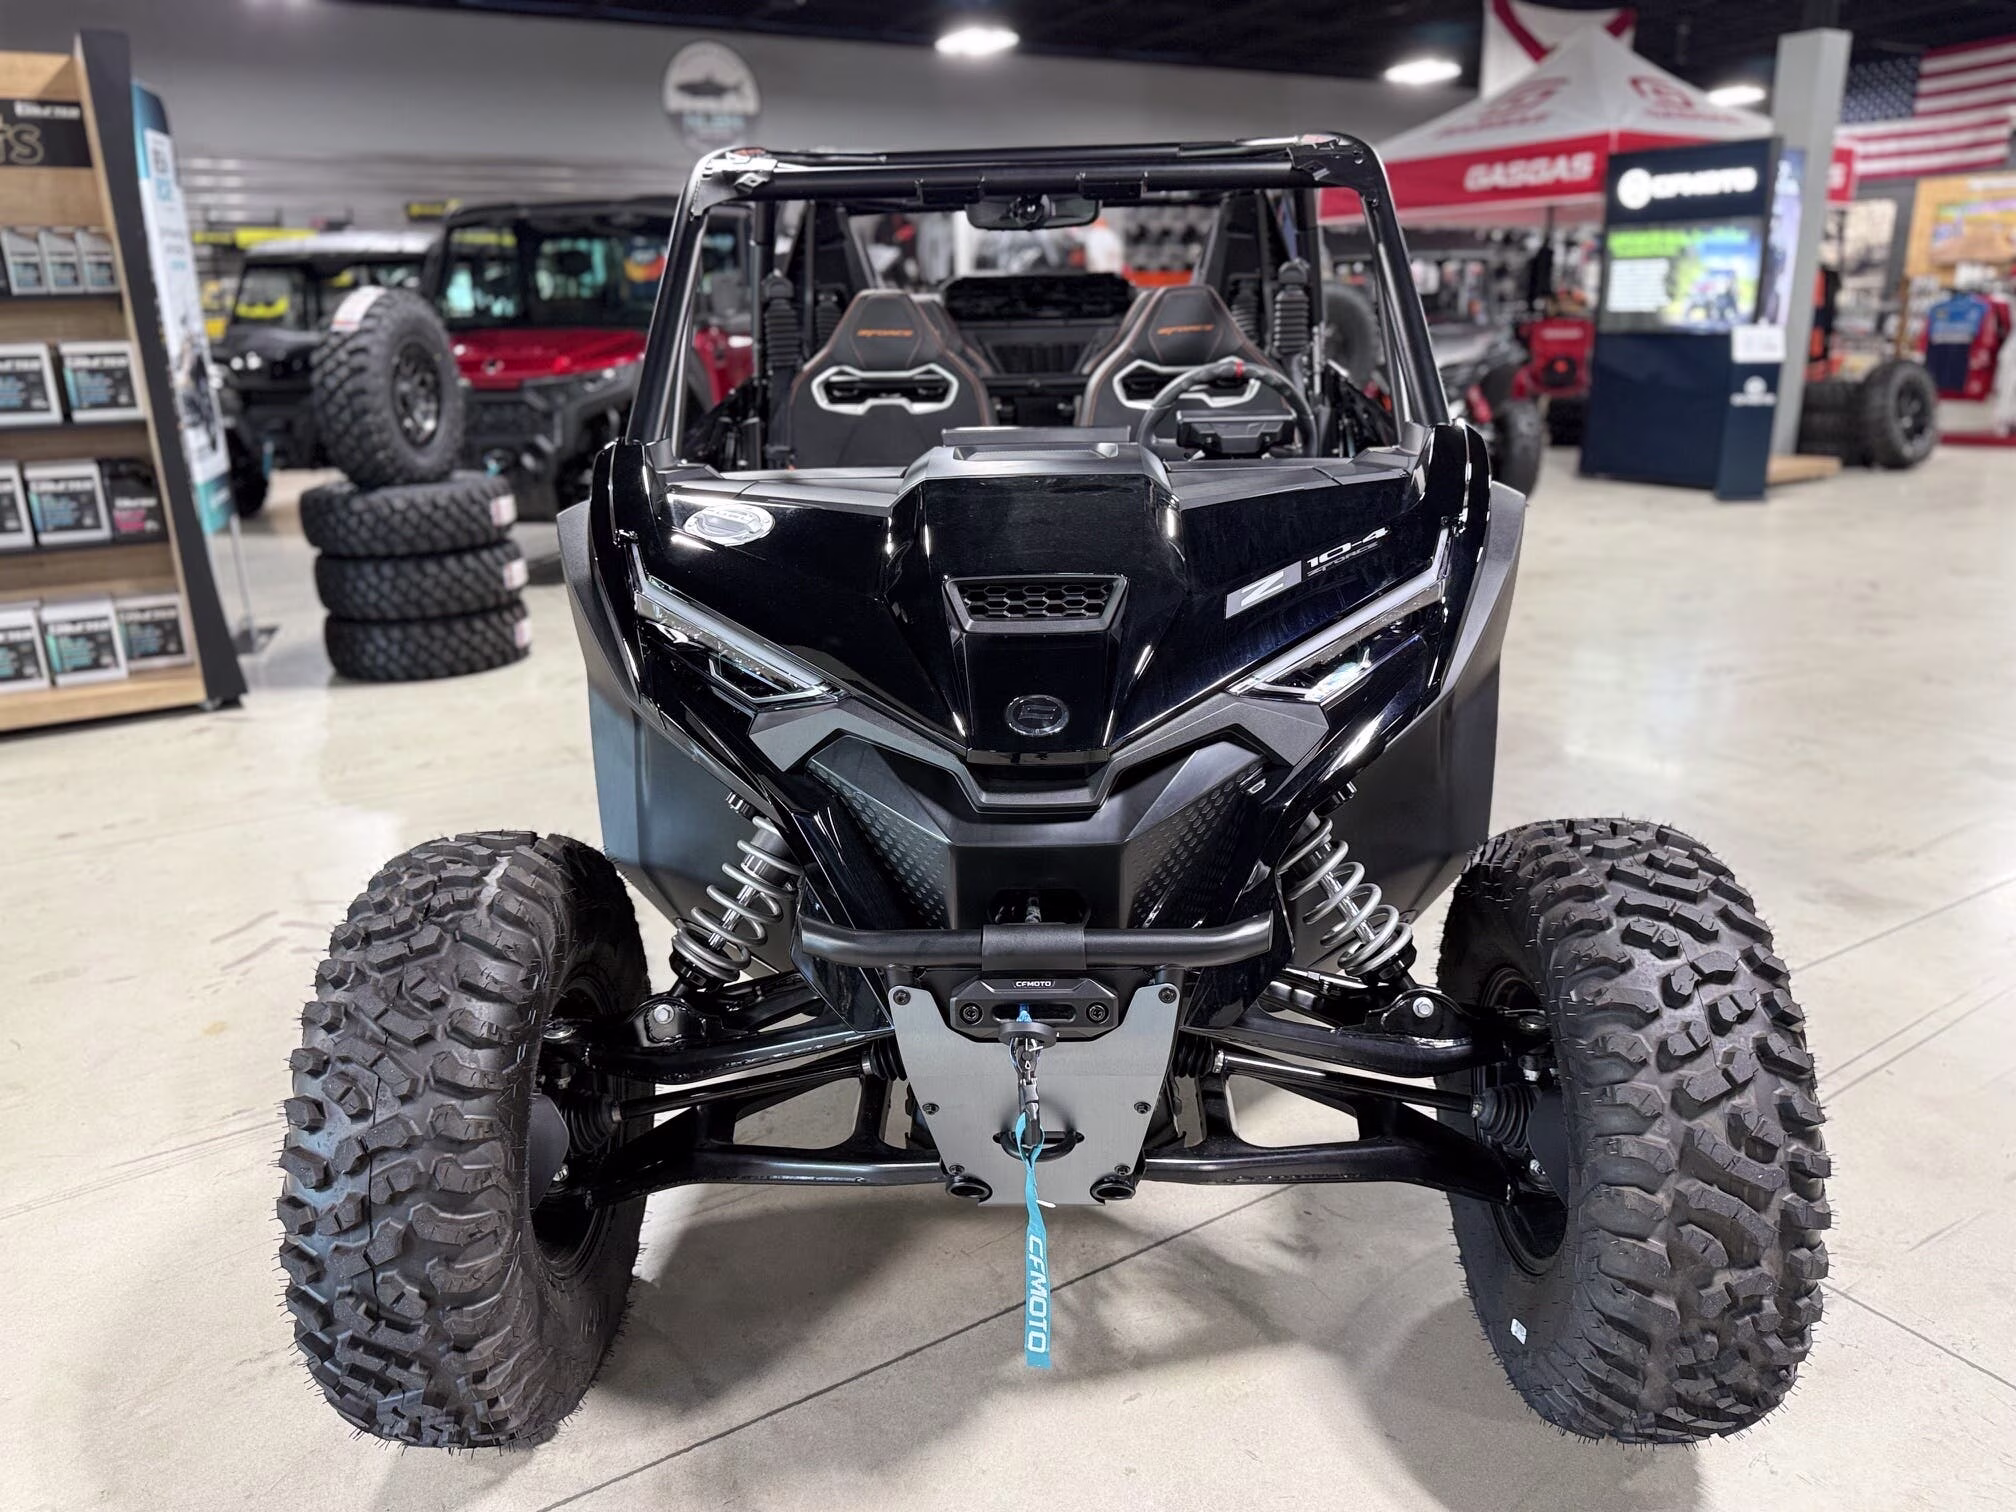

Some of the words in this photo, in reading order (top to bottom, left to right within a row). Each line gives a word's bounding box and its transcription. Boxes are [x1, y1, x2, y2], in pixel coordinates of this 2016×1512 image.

[1464, 151, 1596, 192] GASGAS
[1241, 571, 1284, 607] Z
[1015, 980, 1052, 988] CFMOTO
[1027, 1234, 1049, 1353] CFMOTO
